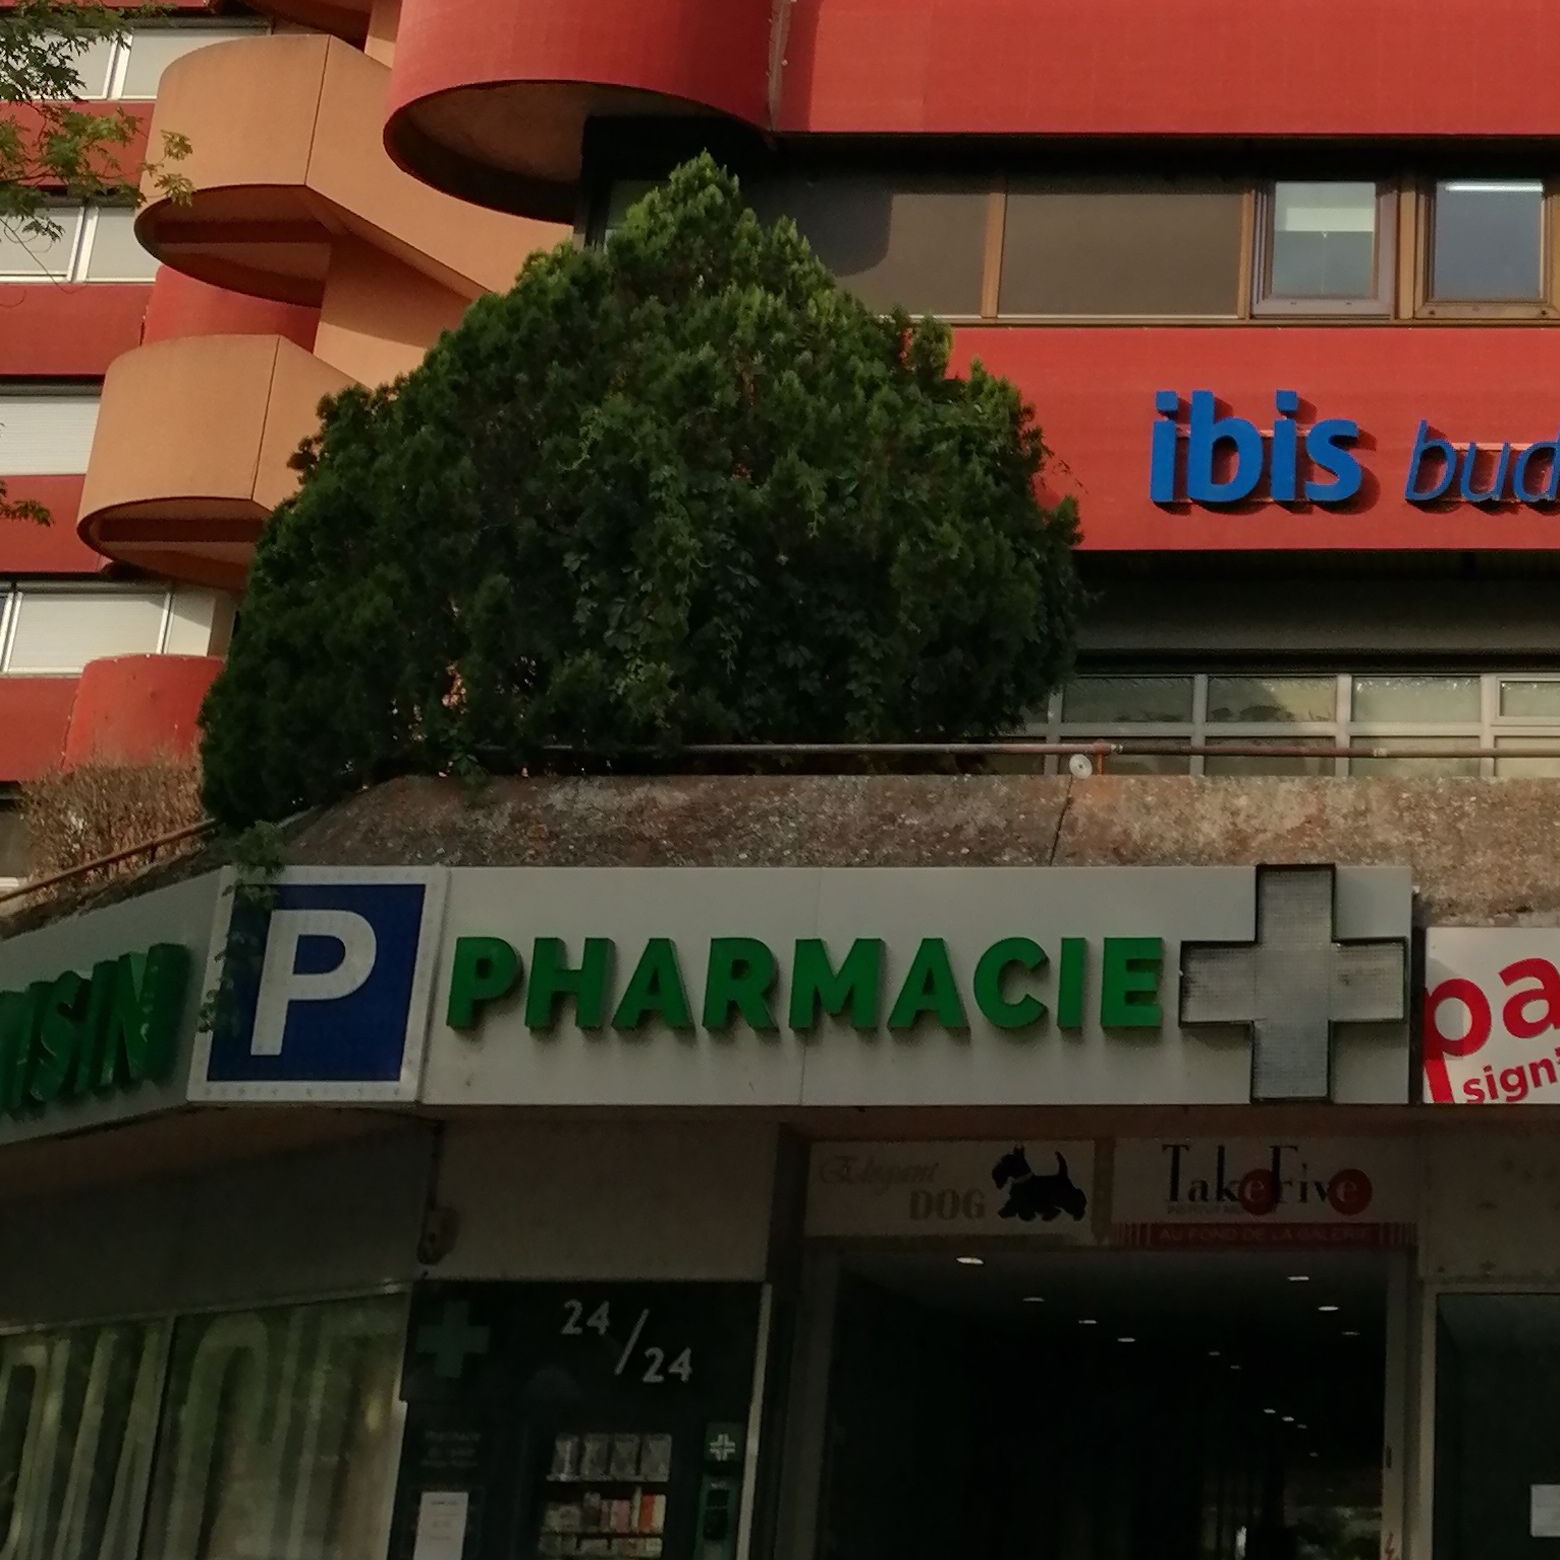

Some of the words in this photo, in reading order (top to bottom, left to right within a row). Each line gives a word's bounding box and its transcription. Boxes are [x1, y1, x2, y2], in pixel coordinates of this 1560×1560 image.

[1149, 390, 1364, 504] ibis
[249, 908, 378, 1057] P
[445, 936, 1164, 1031] PHARMACIE
[909, 1189, 985, 1220] DOG
